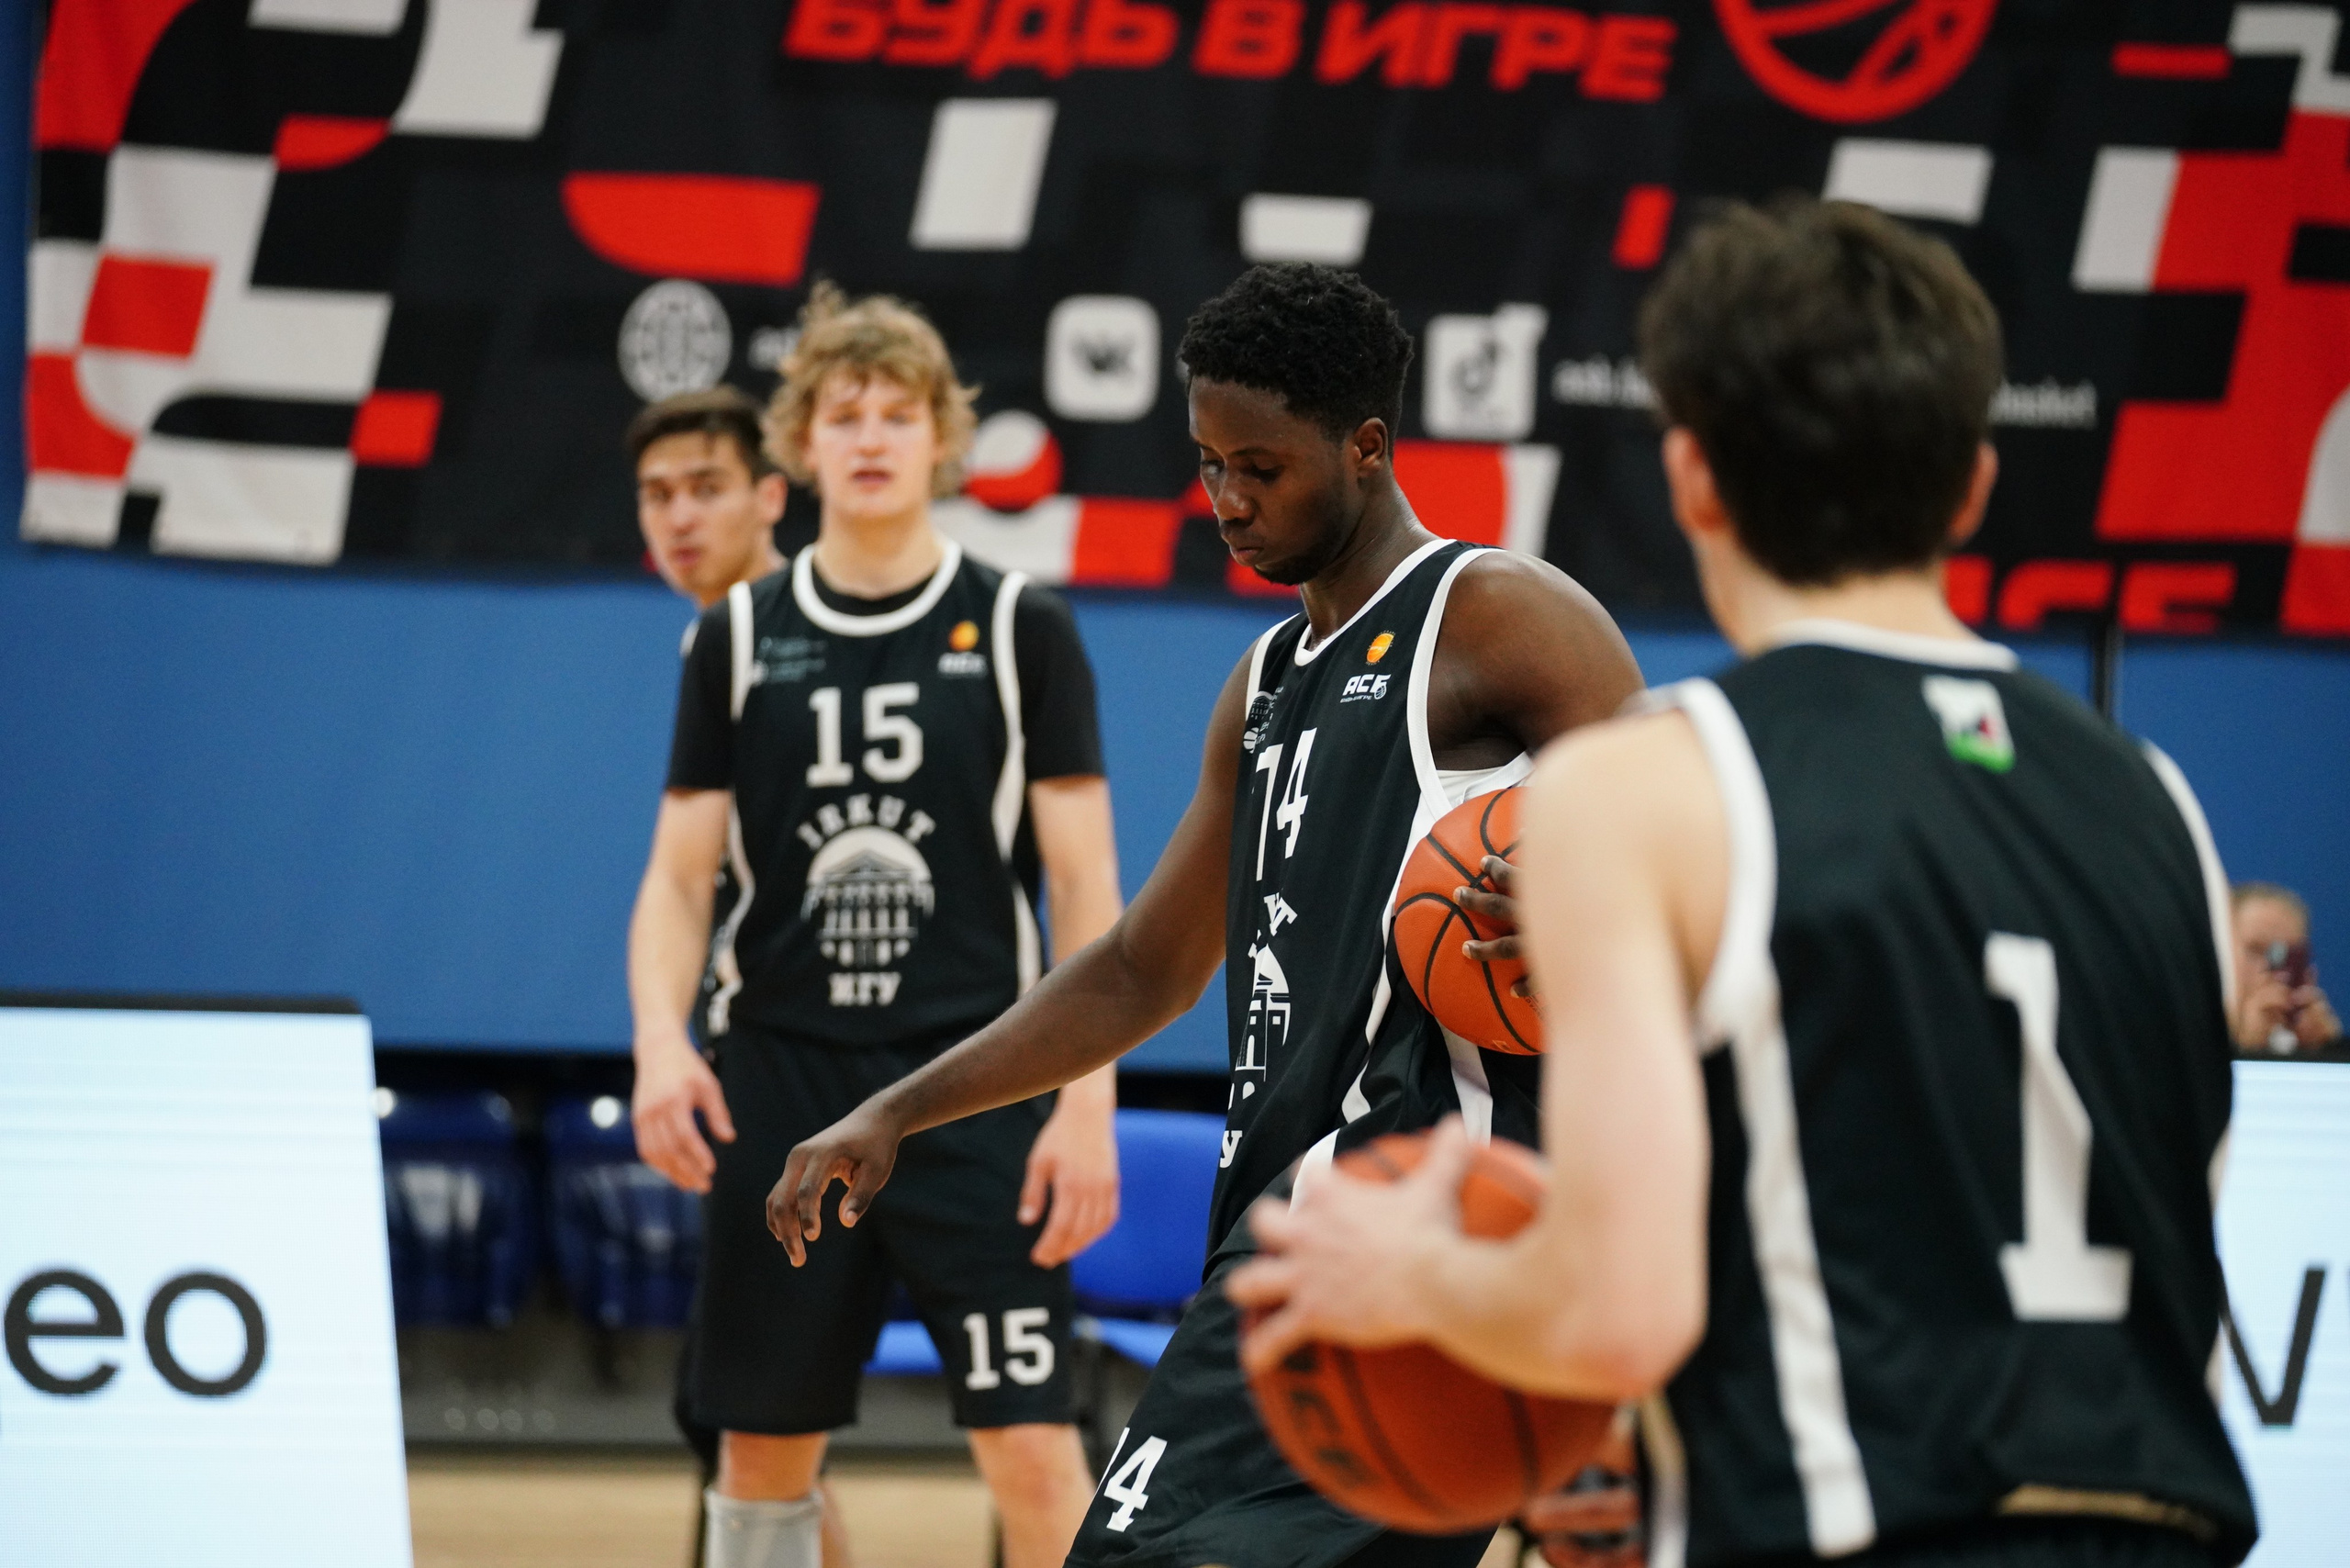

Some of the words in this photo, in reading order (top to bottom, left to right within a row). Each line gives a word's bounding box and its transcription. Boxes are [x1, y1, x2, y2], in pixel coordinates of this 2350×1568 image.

[785, 0, 1180, 79] БУДЬ
[1315, 3, 1677, 101] ИГРЕ
[805, 682, 923, 788] 15
[1984, 931, 2133, 1323] 1
[963, 1306, 1056, 1391] 15
[1091, 1427, 1168, 1532] 4
